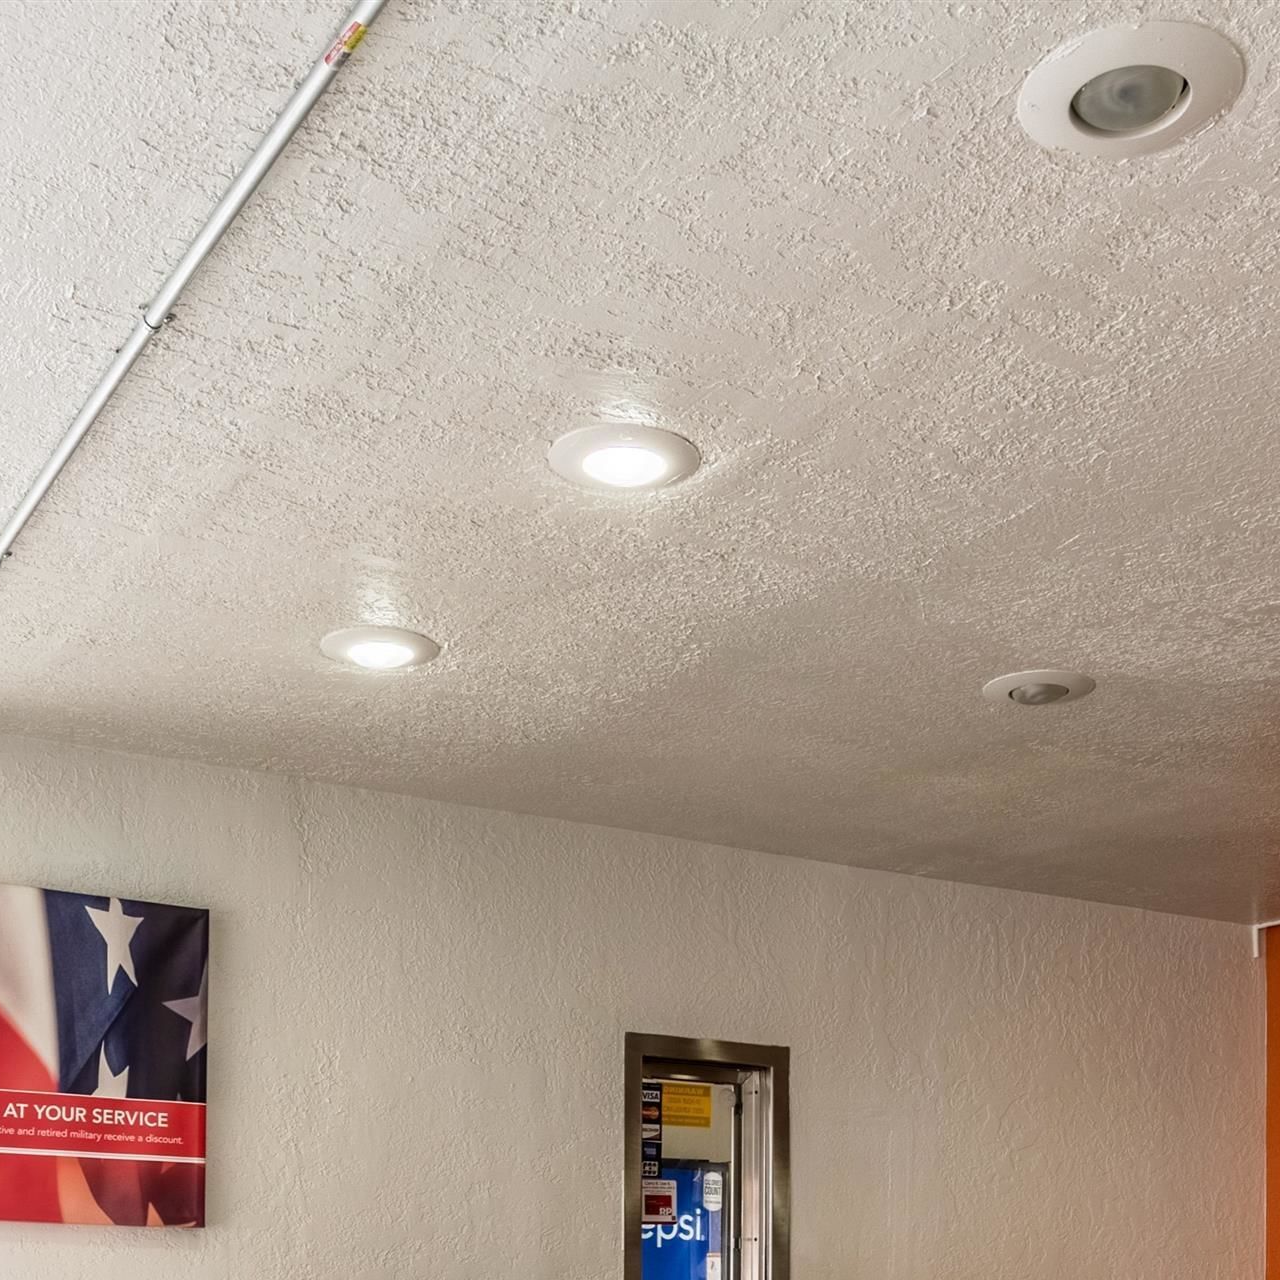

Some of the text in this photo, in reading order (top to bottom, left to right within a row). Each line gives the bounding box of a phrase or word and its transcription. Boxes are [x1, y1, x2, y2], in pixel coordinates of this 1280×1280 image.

[642, 1090, 660, 1100] VISA
[3, 1103, 169, 1128] AT YOUR SERVICE
[17, 1125, 35, 1137] and
[37, 1127, 68, 1138] retired
[69, 1128, 102, 1143] military
[104, 1131, 135, 1143] receive
[137, 1135, 143, 1143] a
[145, 1133, 184, 1145] discount.
[641, 1208, 701, 1248] epsi
